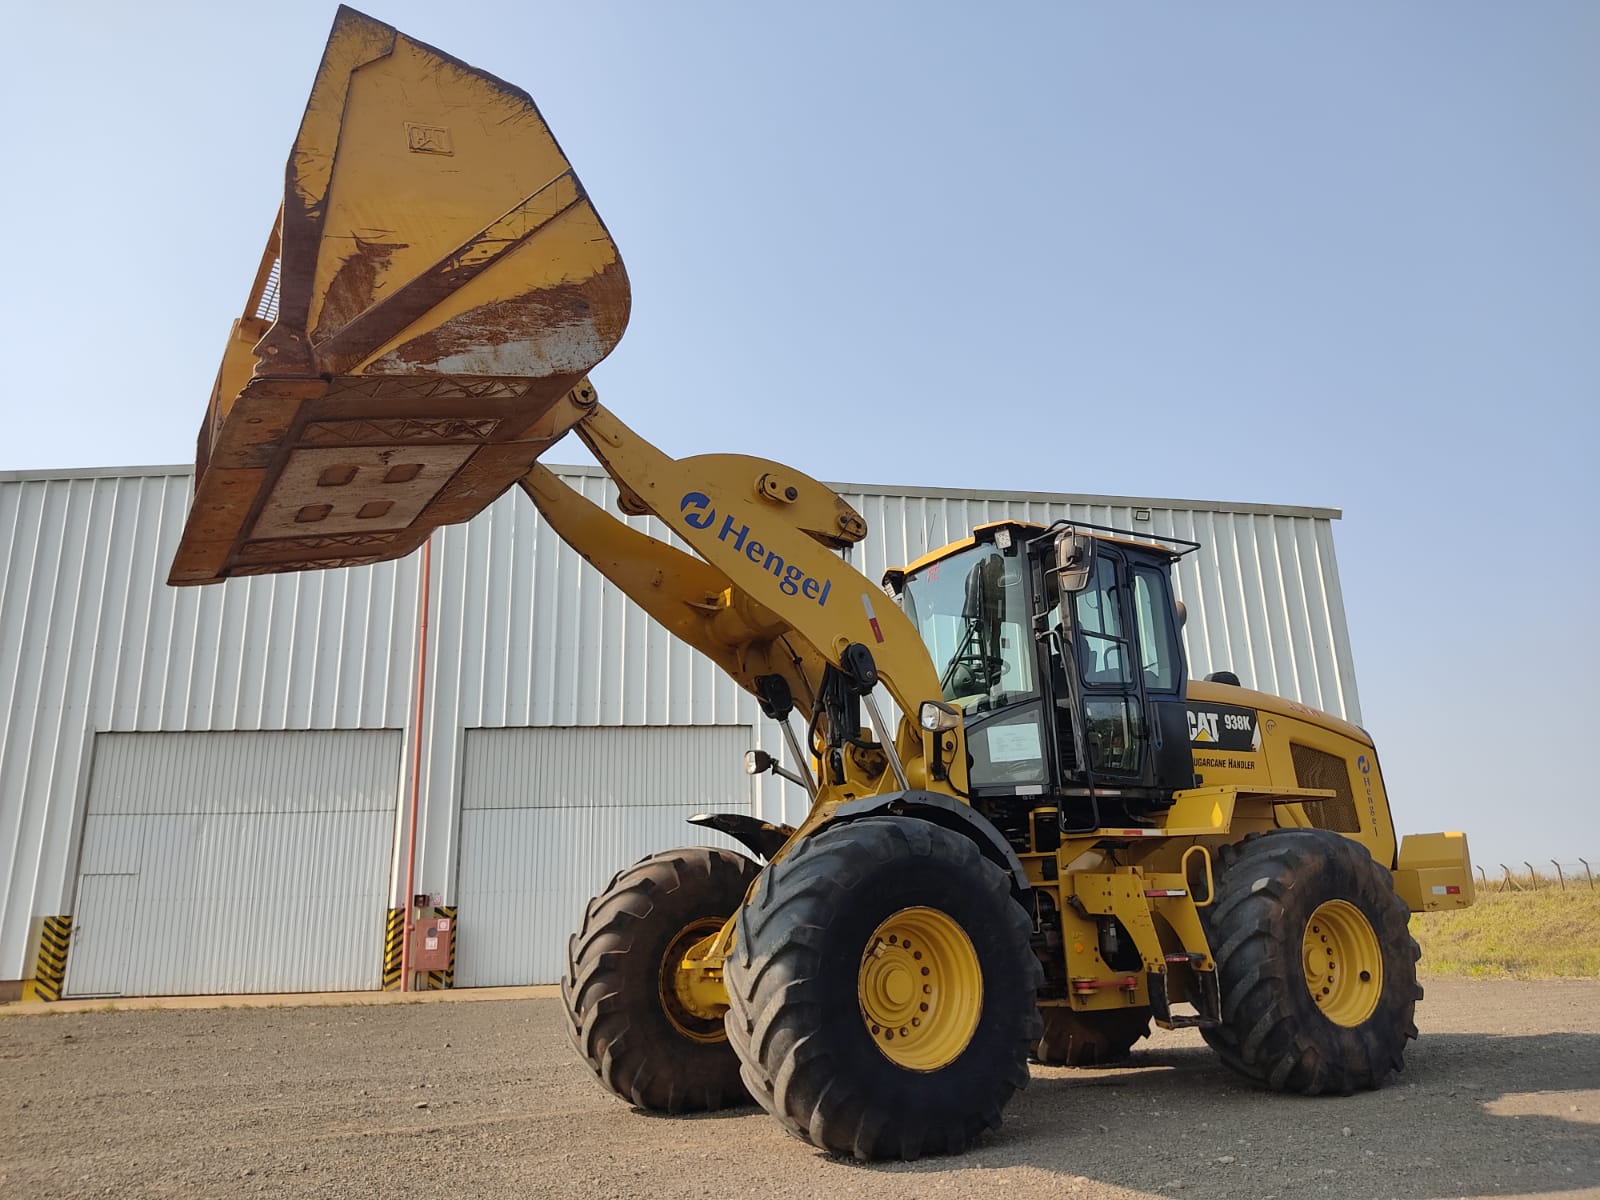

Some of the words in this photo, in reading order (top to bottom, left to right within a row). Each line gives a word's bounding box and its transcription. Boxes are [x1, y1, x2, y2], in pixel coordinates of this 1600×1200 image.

[718, 514, 832, 607] Hengel
[1186, 710, 1220, 743] CAT
[1224, 714, 1251, 731] 938K
[1193, 757, 1226, 768] UGARCANE
[1363, 777, 1378, 837] Hengel
